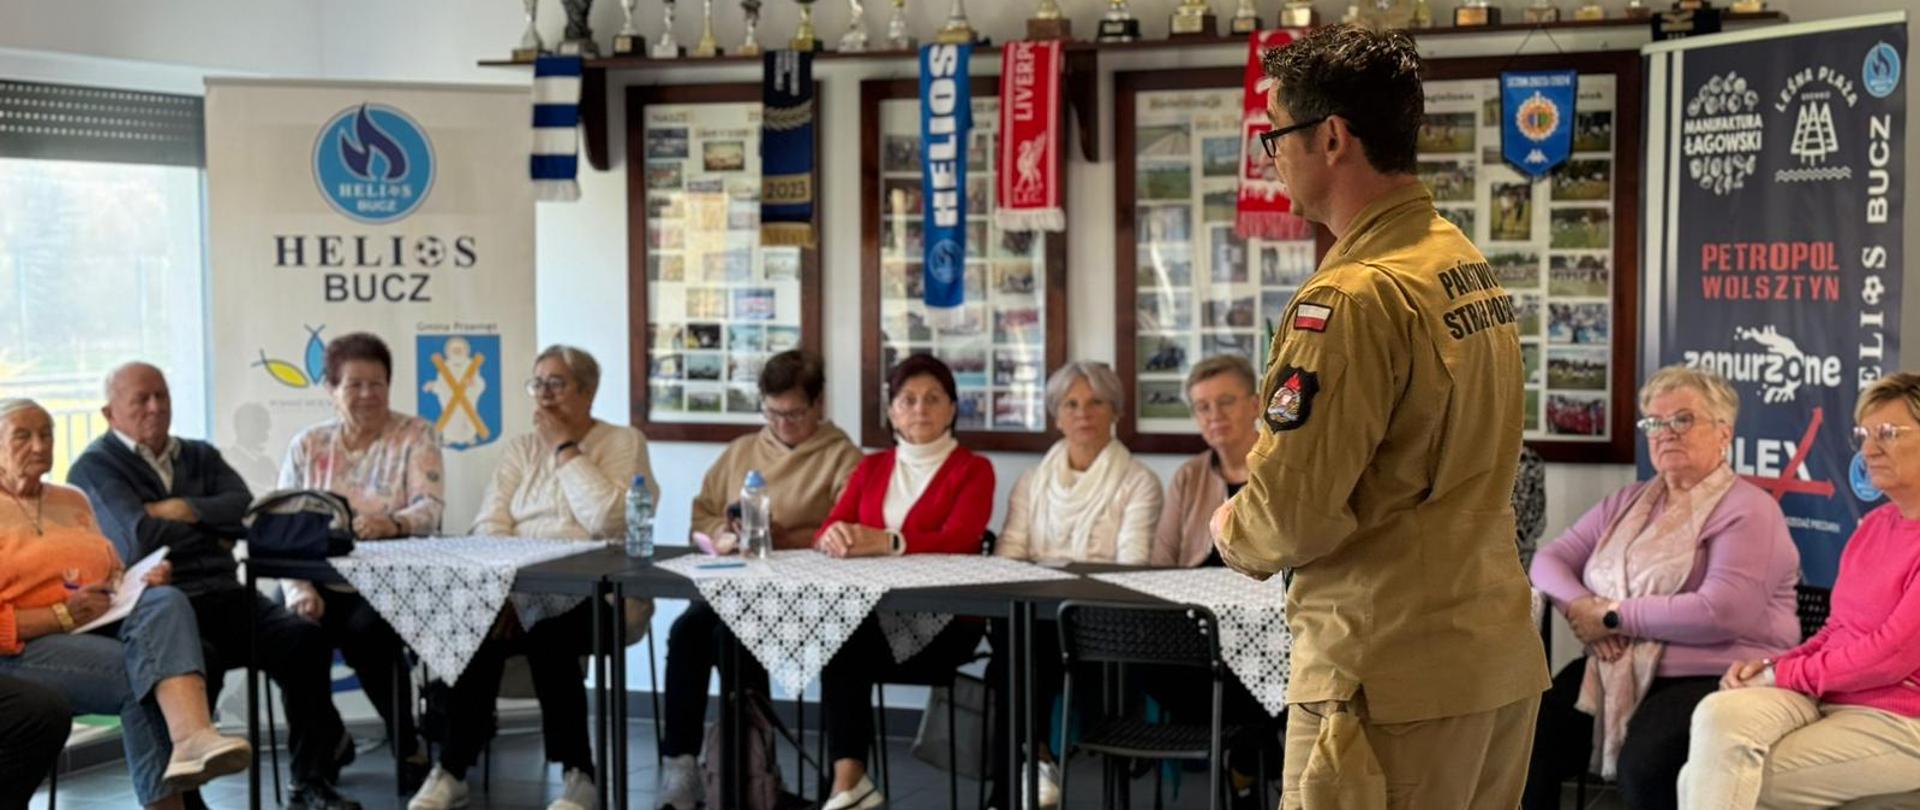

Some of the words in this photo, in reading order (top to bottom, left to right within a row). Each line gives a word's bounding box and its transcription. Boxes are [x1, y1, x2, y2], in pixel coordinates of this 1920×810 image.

[1775, 67, 1813, 112] LEŚNA
[1818, 66, 1858, 108] PLAŻA
[928, 44, 959, 228] HELIOS
[1684, 113, 1763, 134] MANUFAKTURA
[1684, 131, 1762, 155] ŁAGOWSKI
[1866, 114, 1891, 223] BUCZ
[339, 183, 412, 197] HELIOS
[766, 181, 806, 198] 2023
[356, 200, 397, 212] BUCZ
[274, 235, 477, 268] HELIOS
[1702, 242, 1840, 271] PETROPOL
[324, 273, 432, 302] BUCZ
[1702, 275, 1840, 301] WOLSZTYN
[1857, 245, 1887, 391] ELIOS
